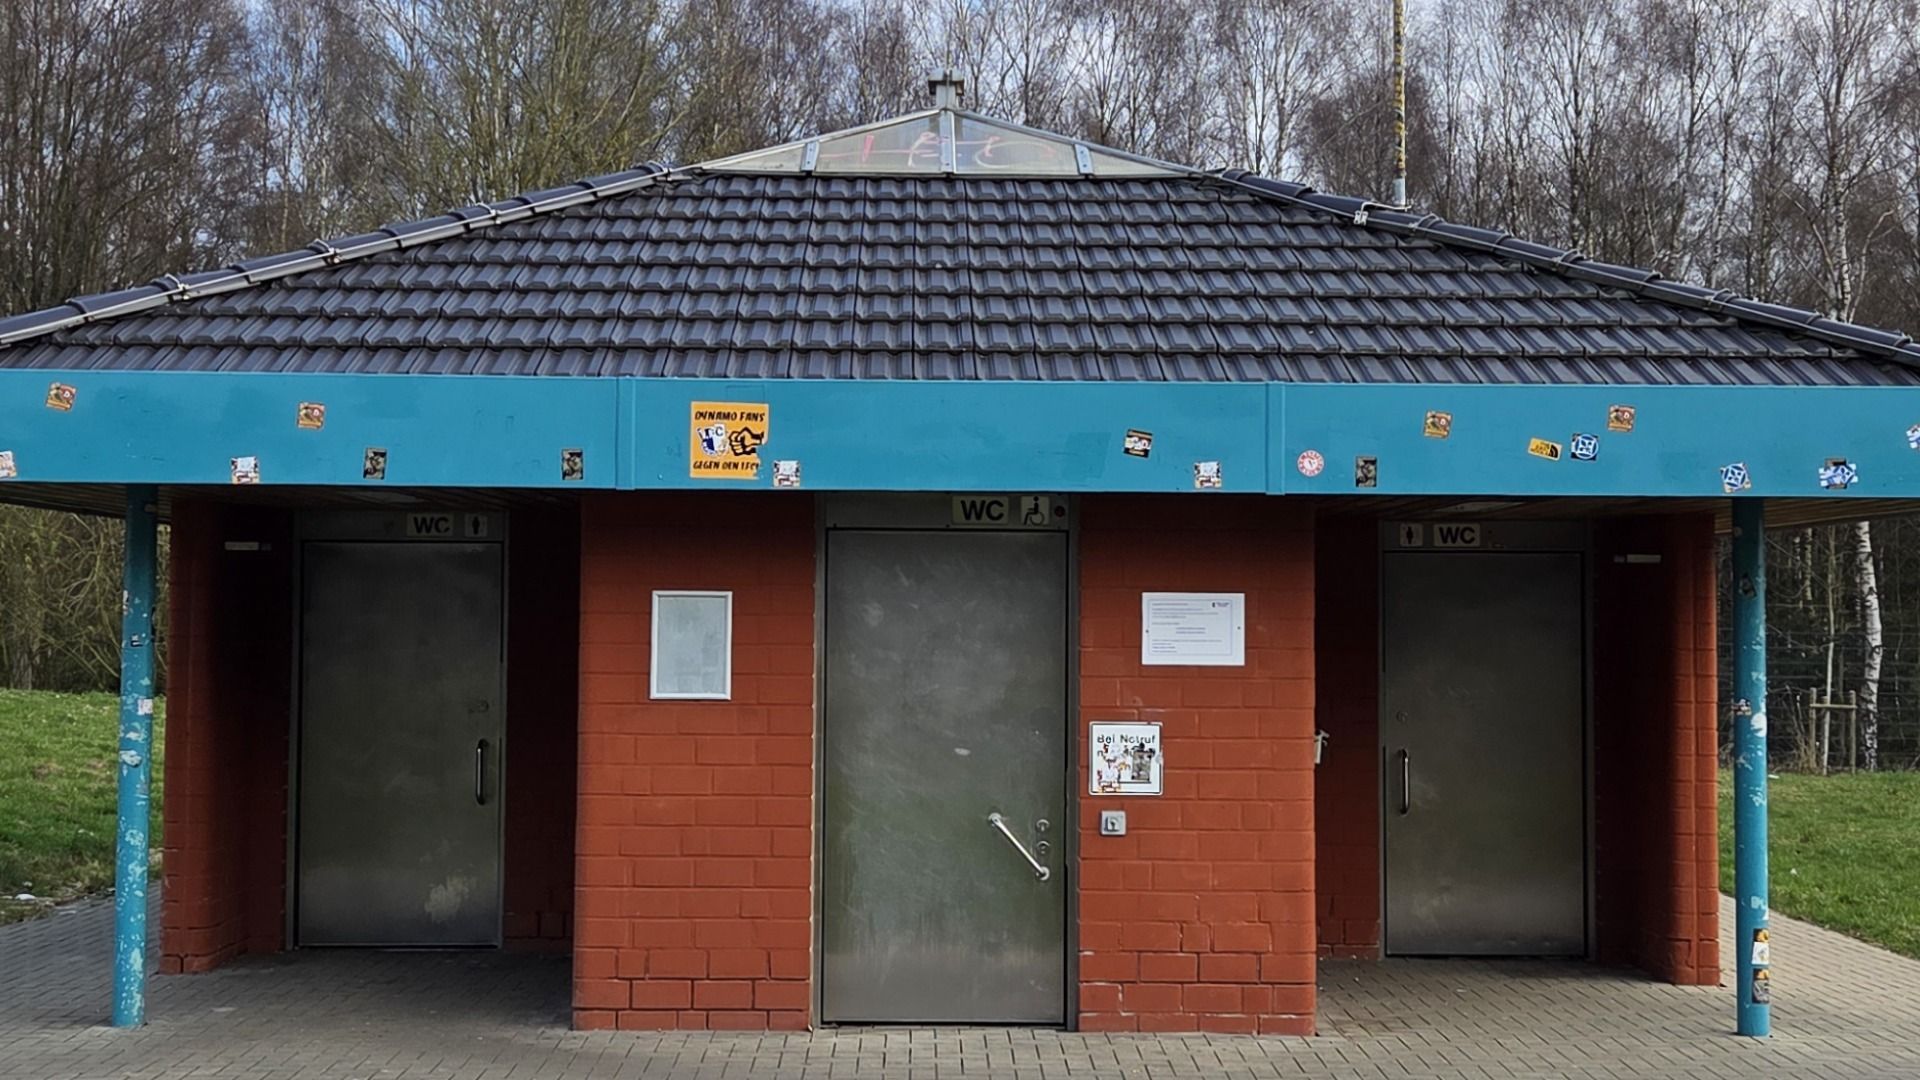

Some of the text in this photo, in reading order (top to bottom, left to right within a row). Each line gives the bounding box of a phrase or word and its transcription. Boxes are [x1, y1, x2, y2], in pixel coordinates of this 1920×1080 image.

[694, 411, 765, 422] DYNAMO FANS
[693, 461, 720, 469] GEGEN
[722, 461, 739, 470] DEN
[960, 499, 1005, 521] WC
[413, 516, 450, 533] WC
[1438, 526, 1476, 545] WC
